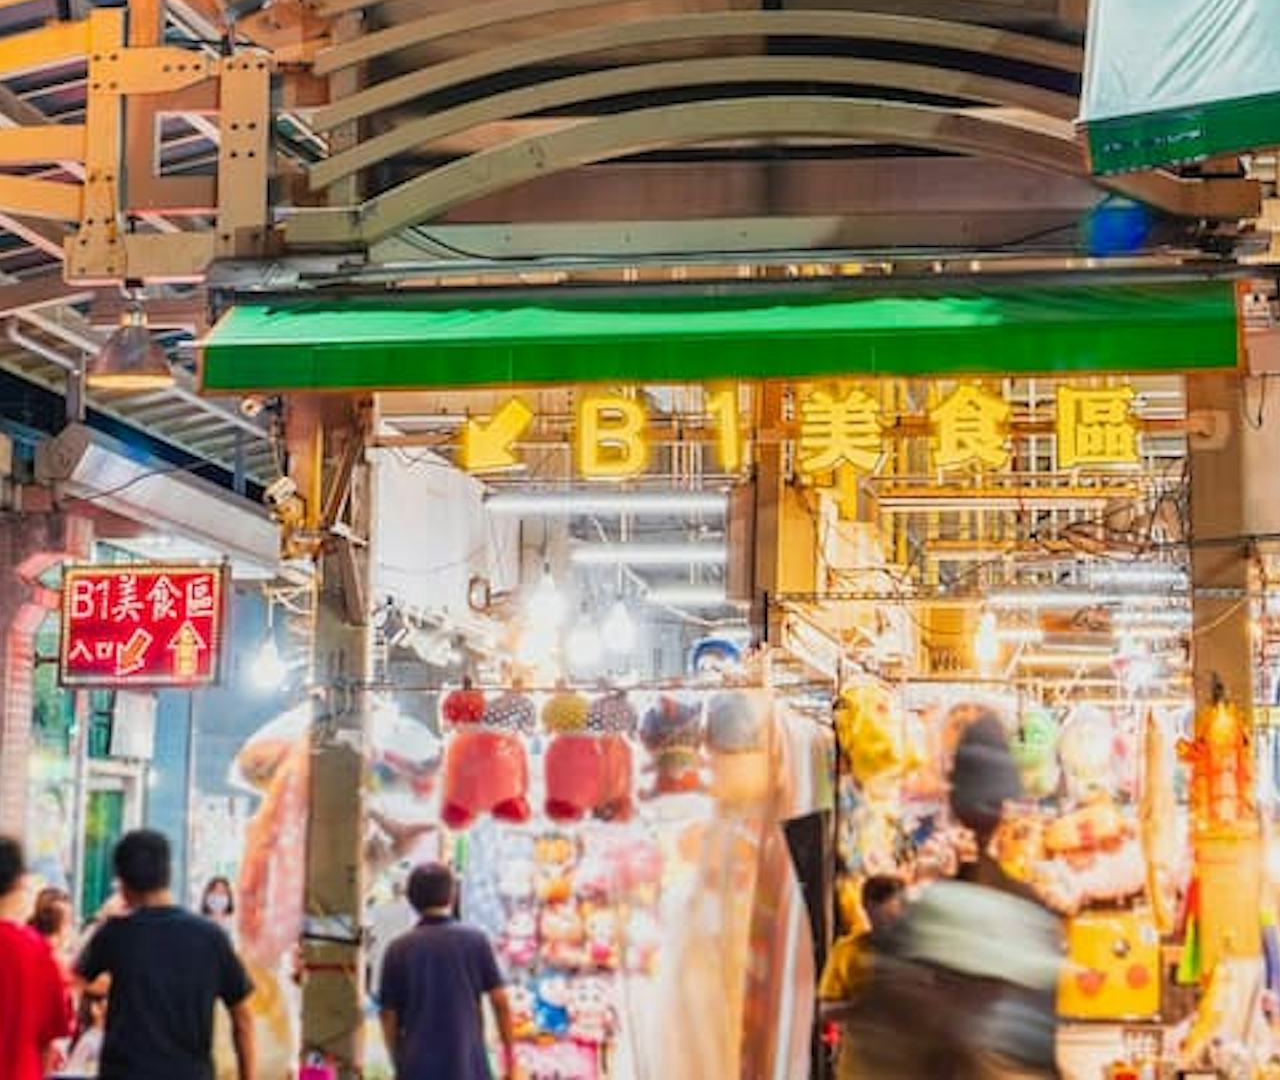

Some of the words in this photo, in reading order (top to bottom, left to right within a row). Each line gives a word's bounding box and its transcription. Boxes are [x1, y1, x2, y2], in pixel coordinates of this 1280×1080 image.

[577, 383, 1140, 481] B1美食區
[70, 574, 214, 622] B1美食區
[68, 639, 115, 663] 入口
